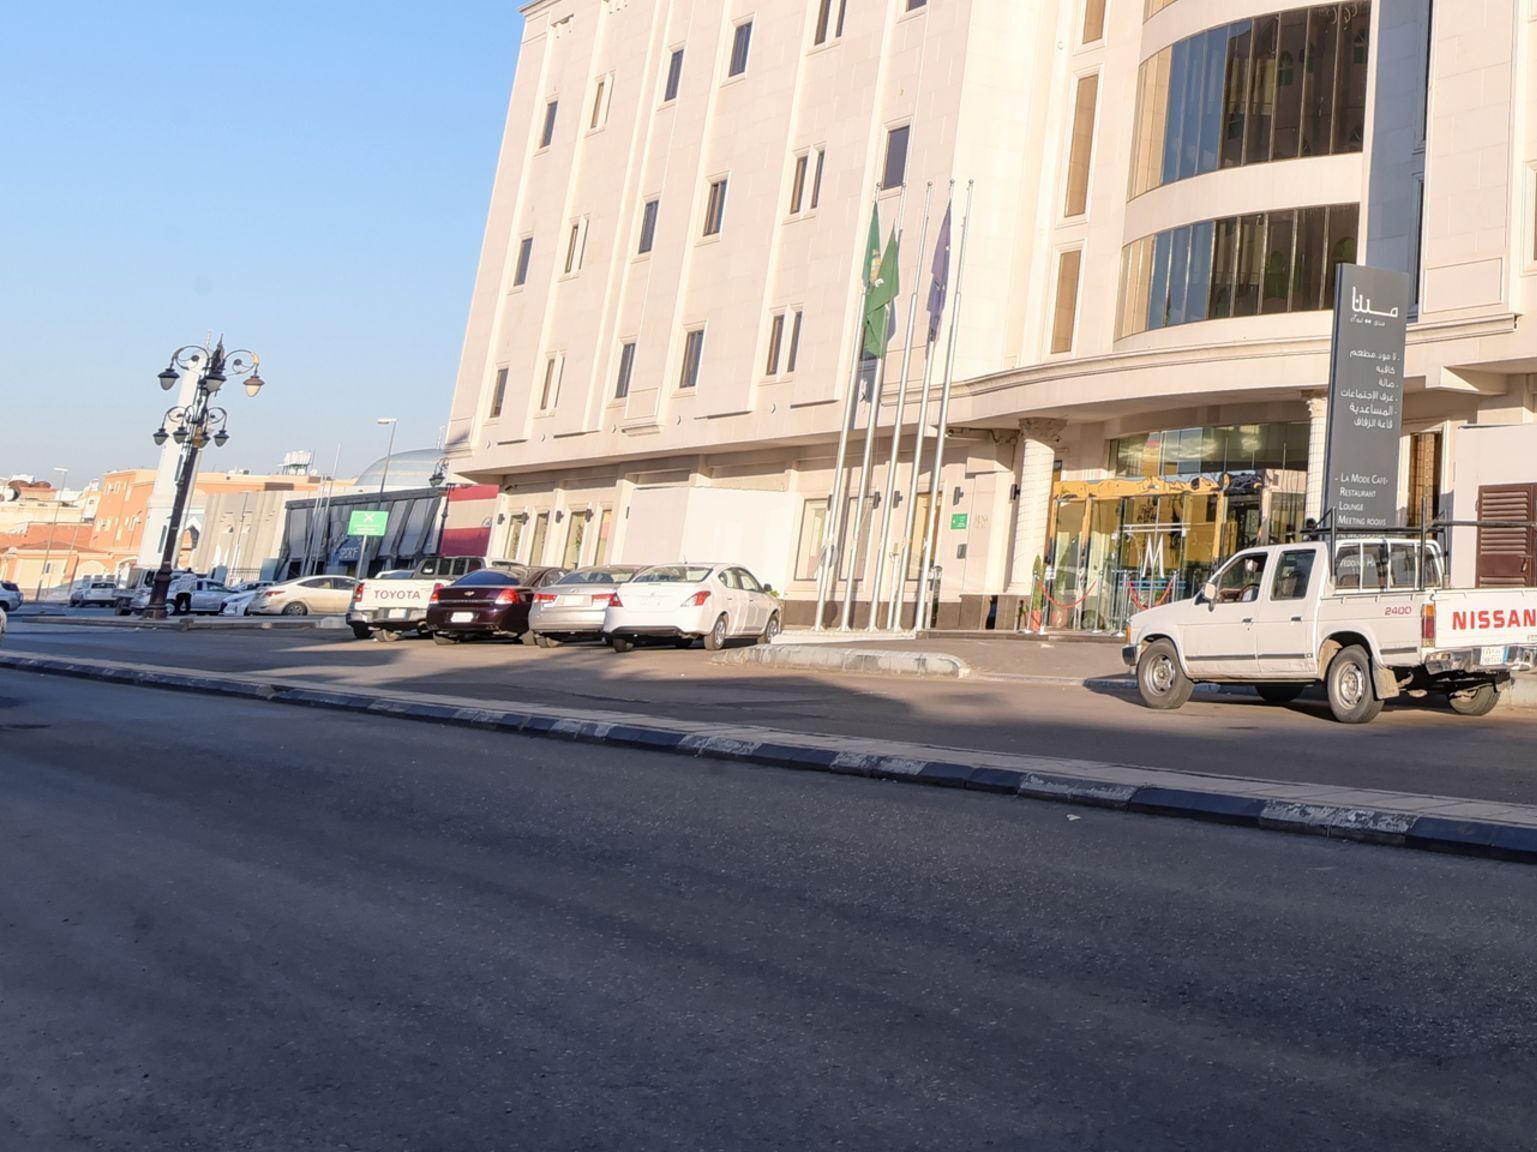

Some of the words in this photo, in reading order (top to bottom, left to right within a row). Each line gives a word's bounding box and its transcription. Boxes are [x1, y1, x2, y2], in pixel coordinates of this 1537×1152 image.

[1352, 286, 1398, 318] مينا
[1338, 501, 1364, 511] LOUNGE
[1141, 533, 1164, 578] M
[374, 590, 421, 600] TOYOTA
[1384, 606, 1412, 615] 2400
[1452, 609, 1537, 630] NISSAN
